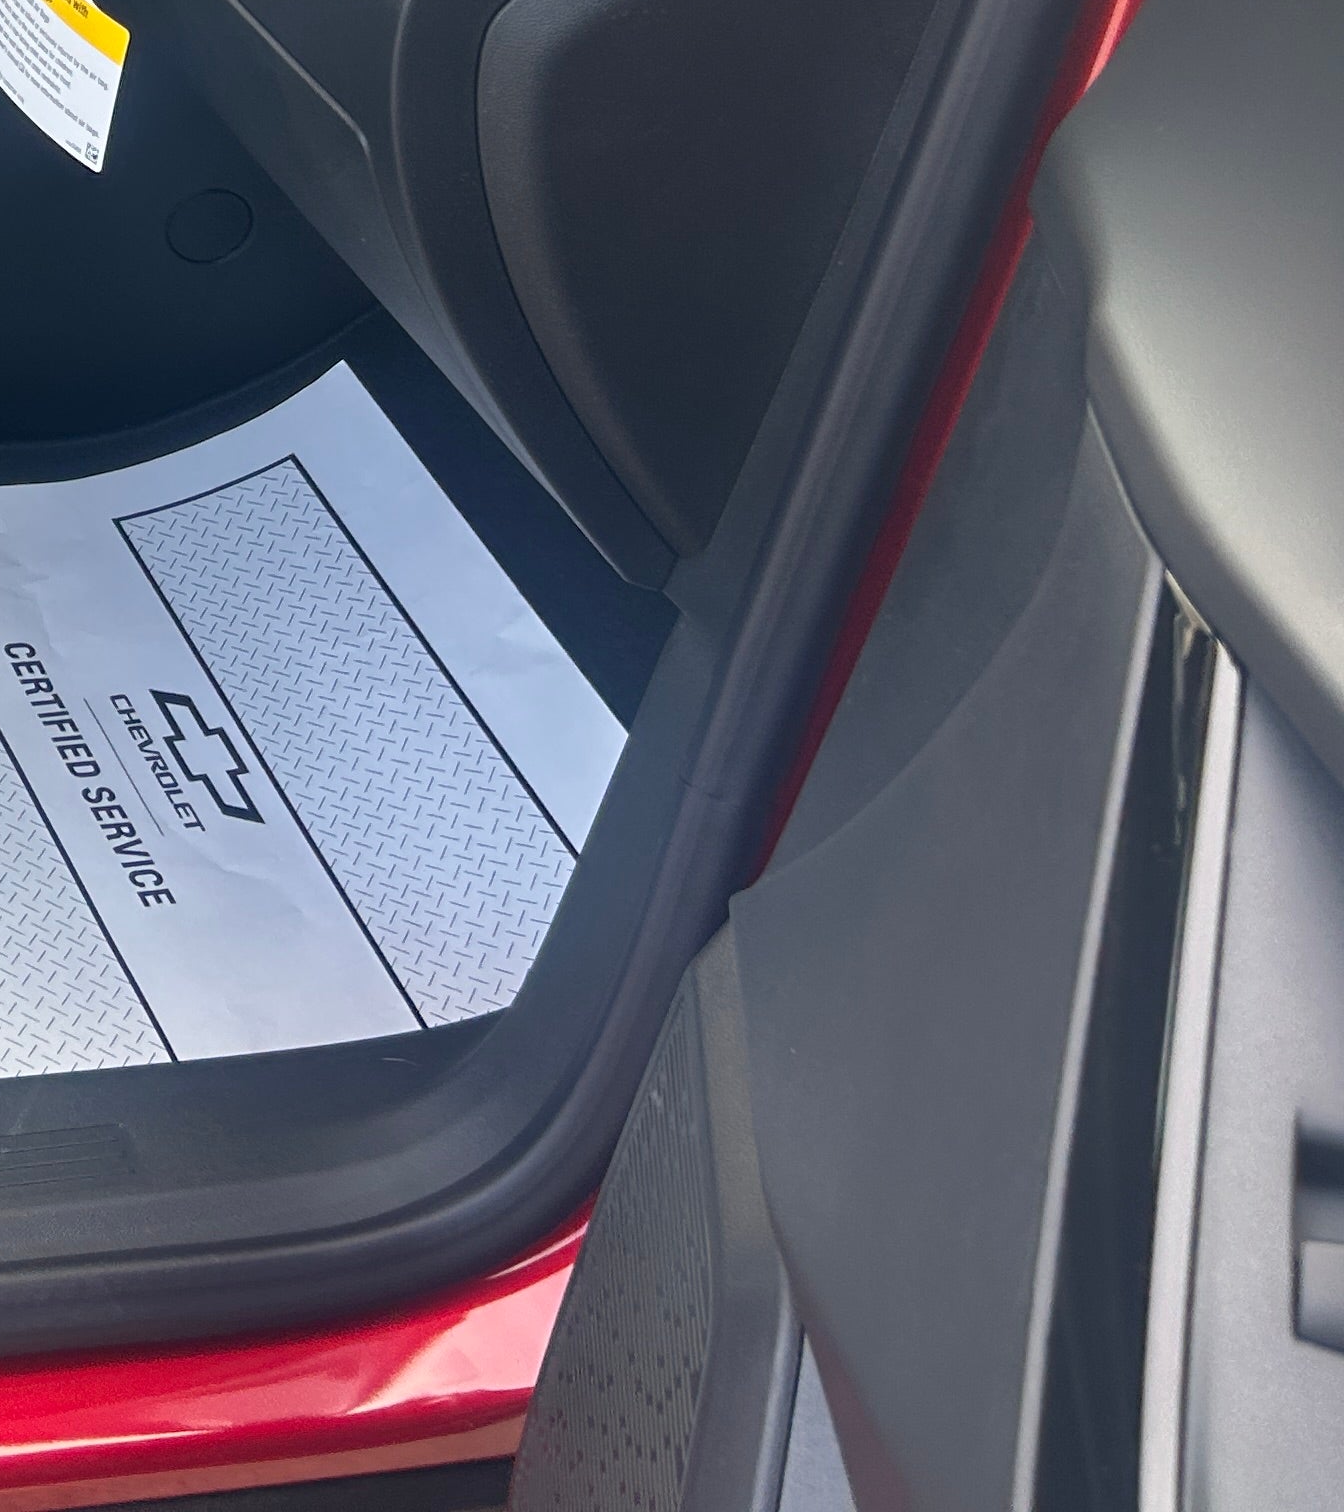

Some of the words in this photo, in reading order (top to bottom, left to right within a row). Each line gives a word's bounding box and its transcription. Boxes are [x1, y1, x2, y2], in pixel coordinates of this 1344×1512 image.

[73, 0, 88, 18] with
[4, 641, 101, 779] CERTIFIED
[81, 786, 177, 908] SERVICE
[109, 693, 206, 832] CHEVROLET
